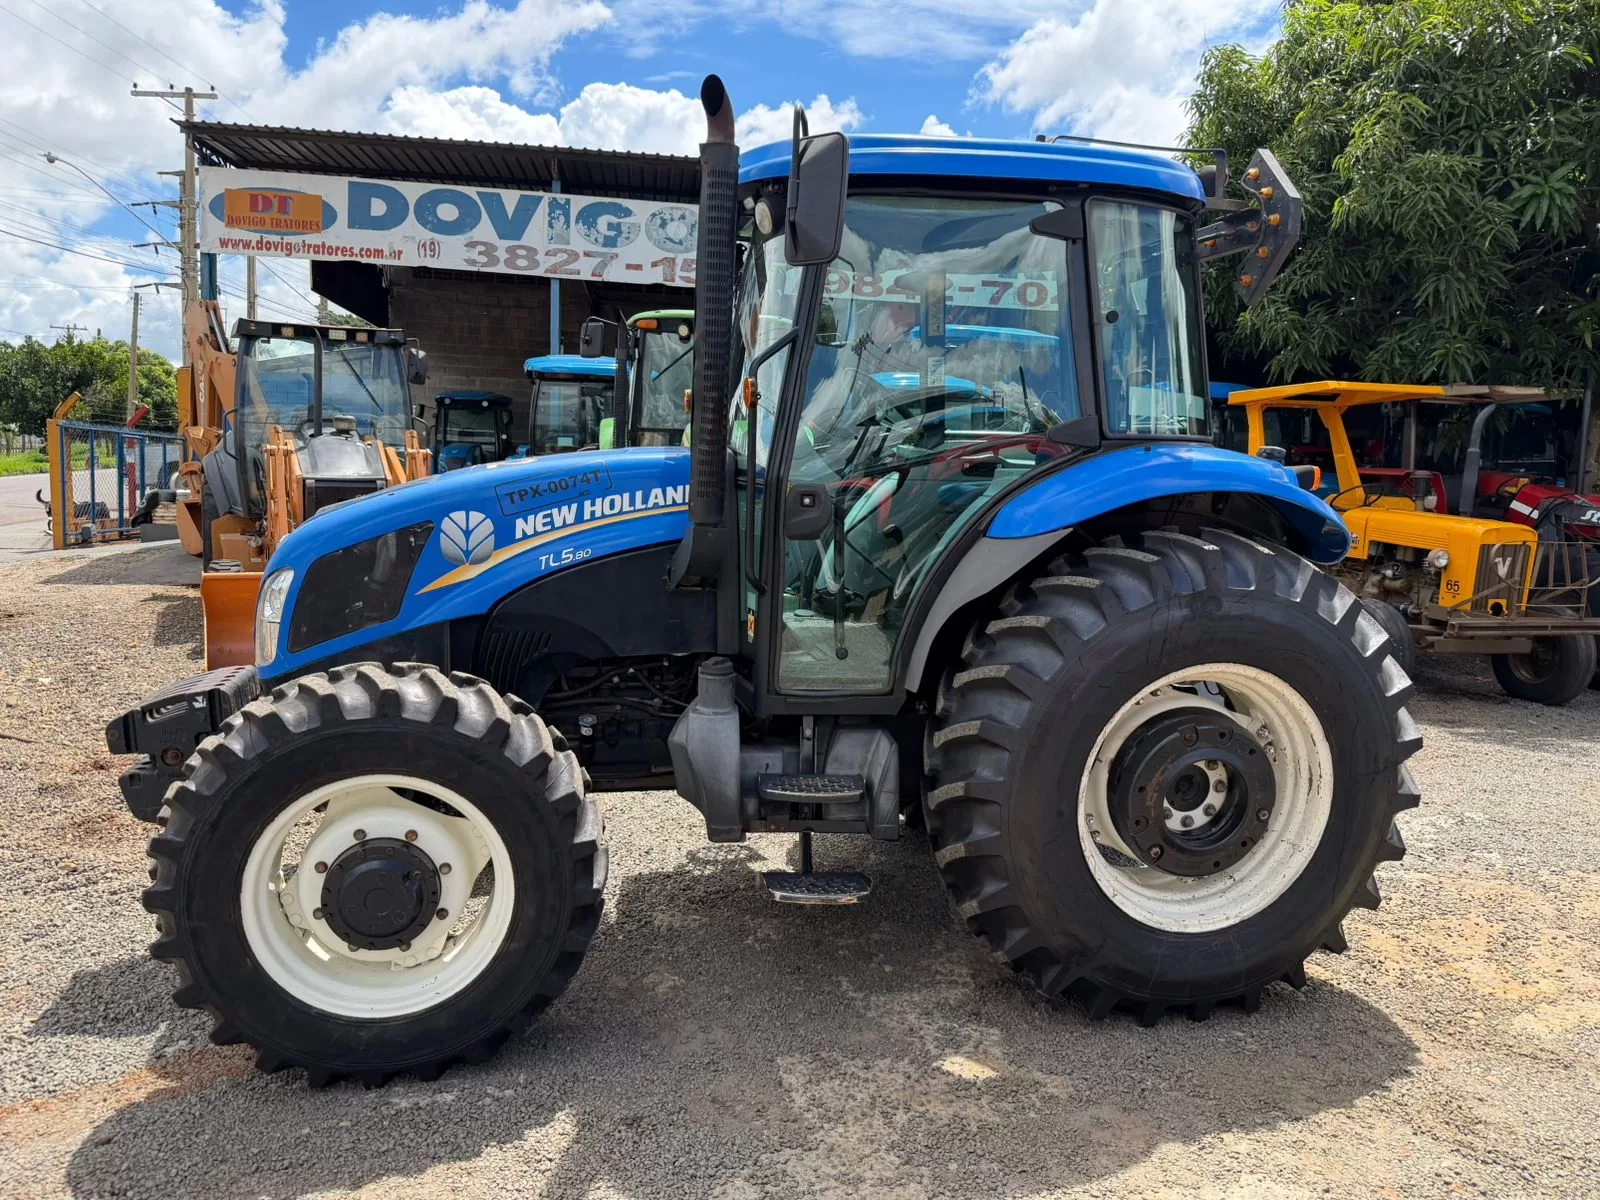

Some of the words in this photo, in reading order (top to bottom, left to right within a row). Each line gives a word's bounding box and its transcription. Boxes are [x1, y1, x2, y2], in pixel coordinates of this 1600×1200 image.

[248, 193, 294, 216] DT
[227, 214, 266, 227] DOVIGO
[270, 217, 320, 231] TRATORES
[348, 181, 697, 254] DOVIGO
[417, 239, 441, 260] (19)
[504, 469, 602, 505] TPX-0074T
[515, 503, 578, 540] NEW
[583, 484, 690, 521] HOLLAN
[539, 547, 592, 570] TL5.80
[1446, 579, 1461, 592] 65
